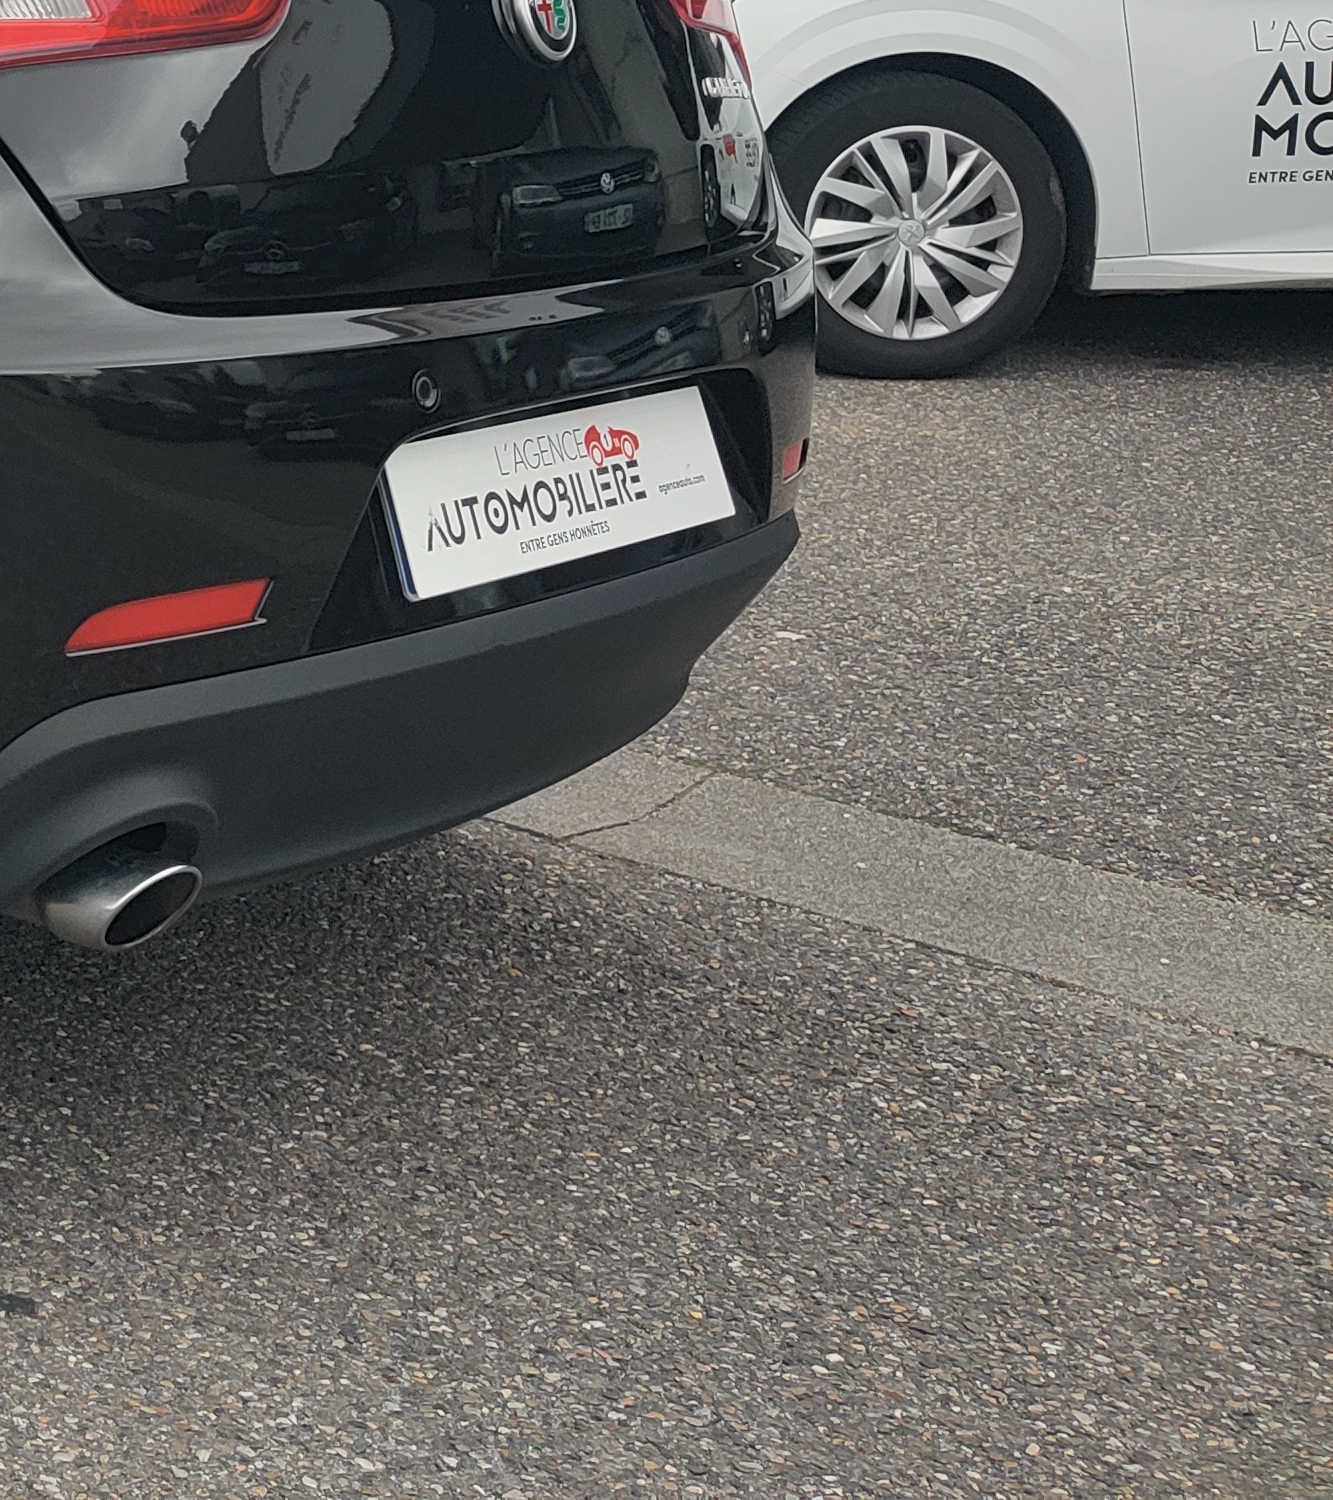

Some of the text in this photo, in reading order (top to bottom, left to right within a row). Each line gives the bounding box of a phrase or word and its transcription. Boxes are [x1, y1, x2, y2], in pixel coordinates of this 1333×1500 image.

[1248, 170, 1298, 184] ENTRE
[493, 428, 588, 477] L'AGENCE
[658, 473, 706, 496] agenceauto.com
[520, 520, 610, 555] ENTRE GENS HONNÊTES
